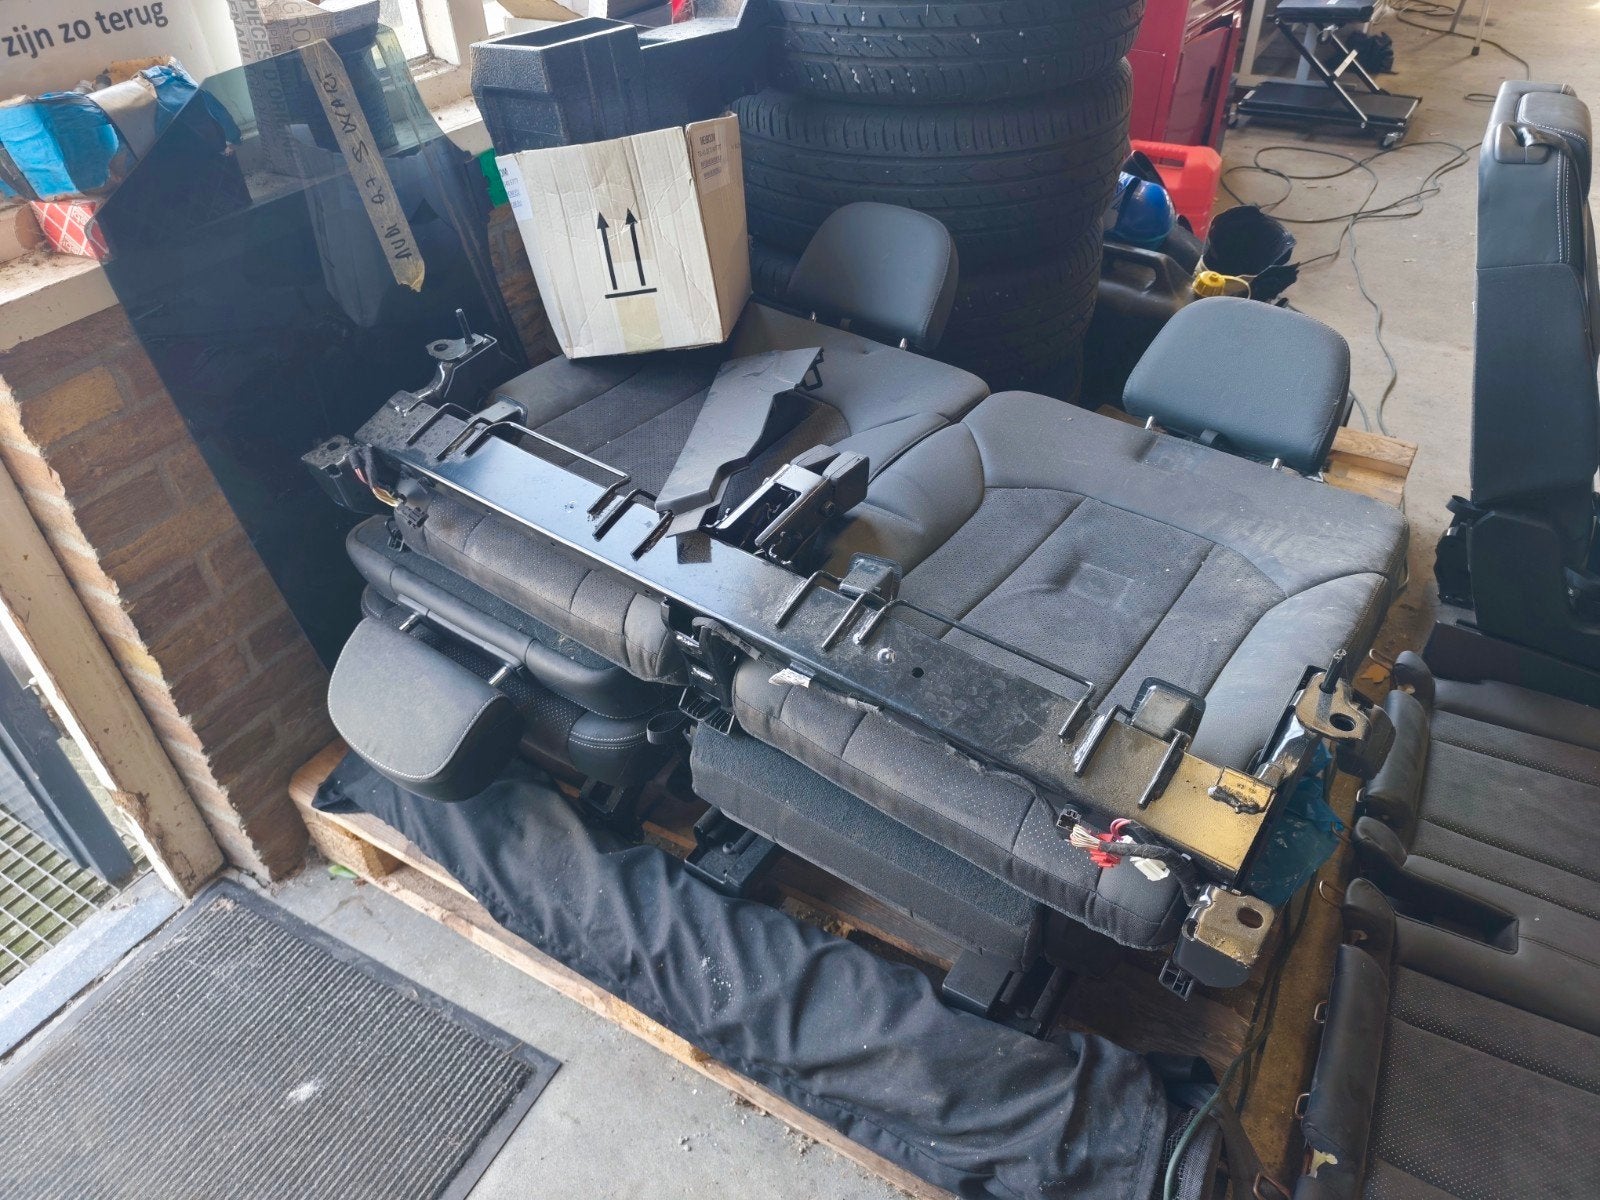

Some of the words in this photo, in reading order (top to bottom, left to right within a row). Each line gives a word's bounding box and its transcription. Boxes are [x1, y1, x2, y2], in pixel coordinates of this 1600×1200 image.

[1, 24, 55, 59] zijn
[58, 19, 91, 44] zo
[95, 2, 169, 35] terug
